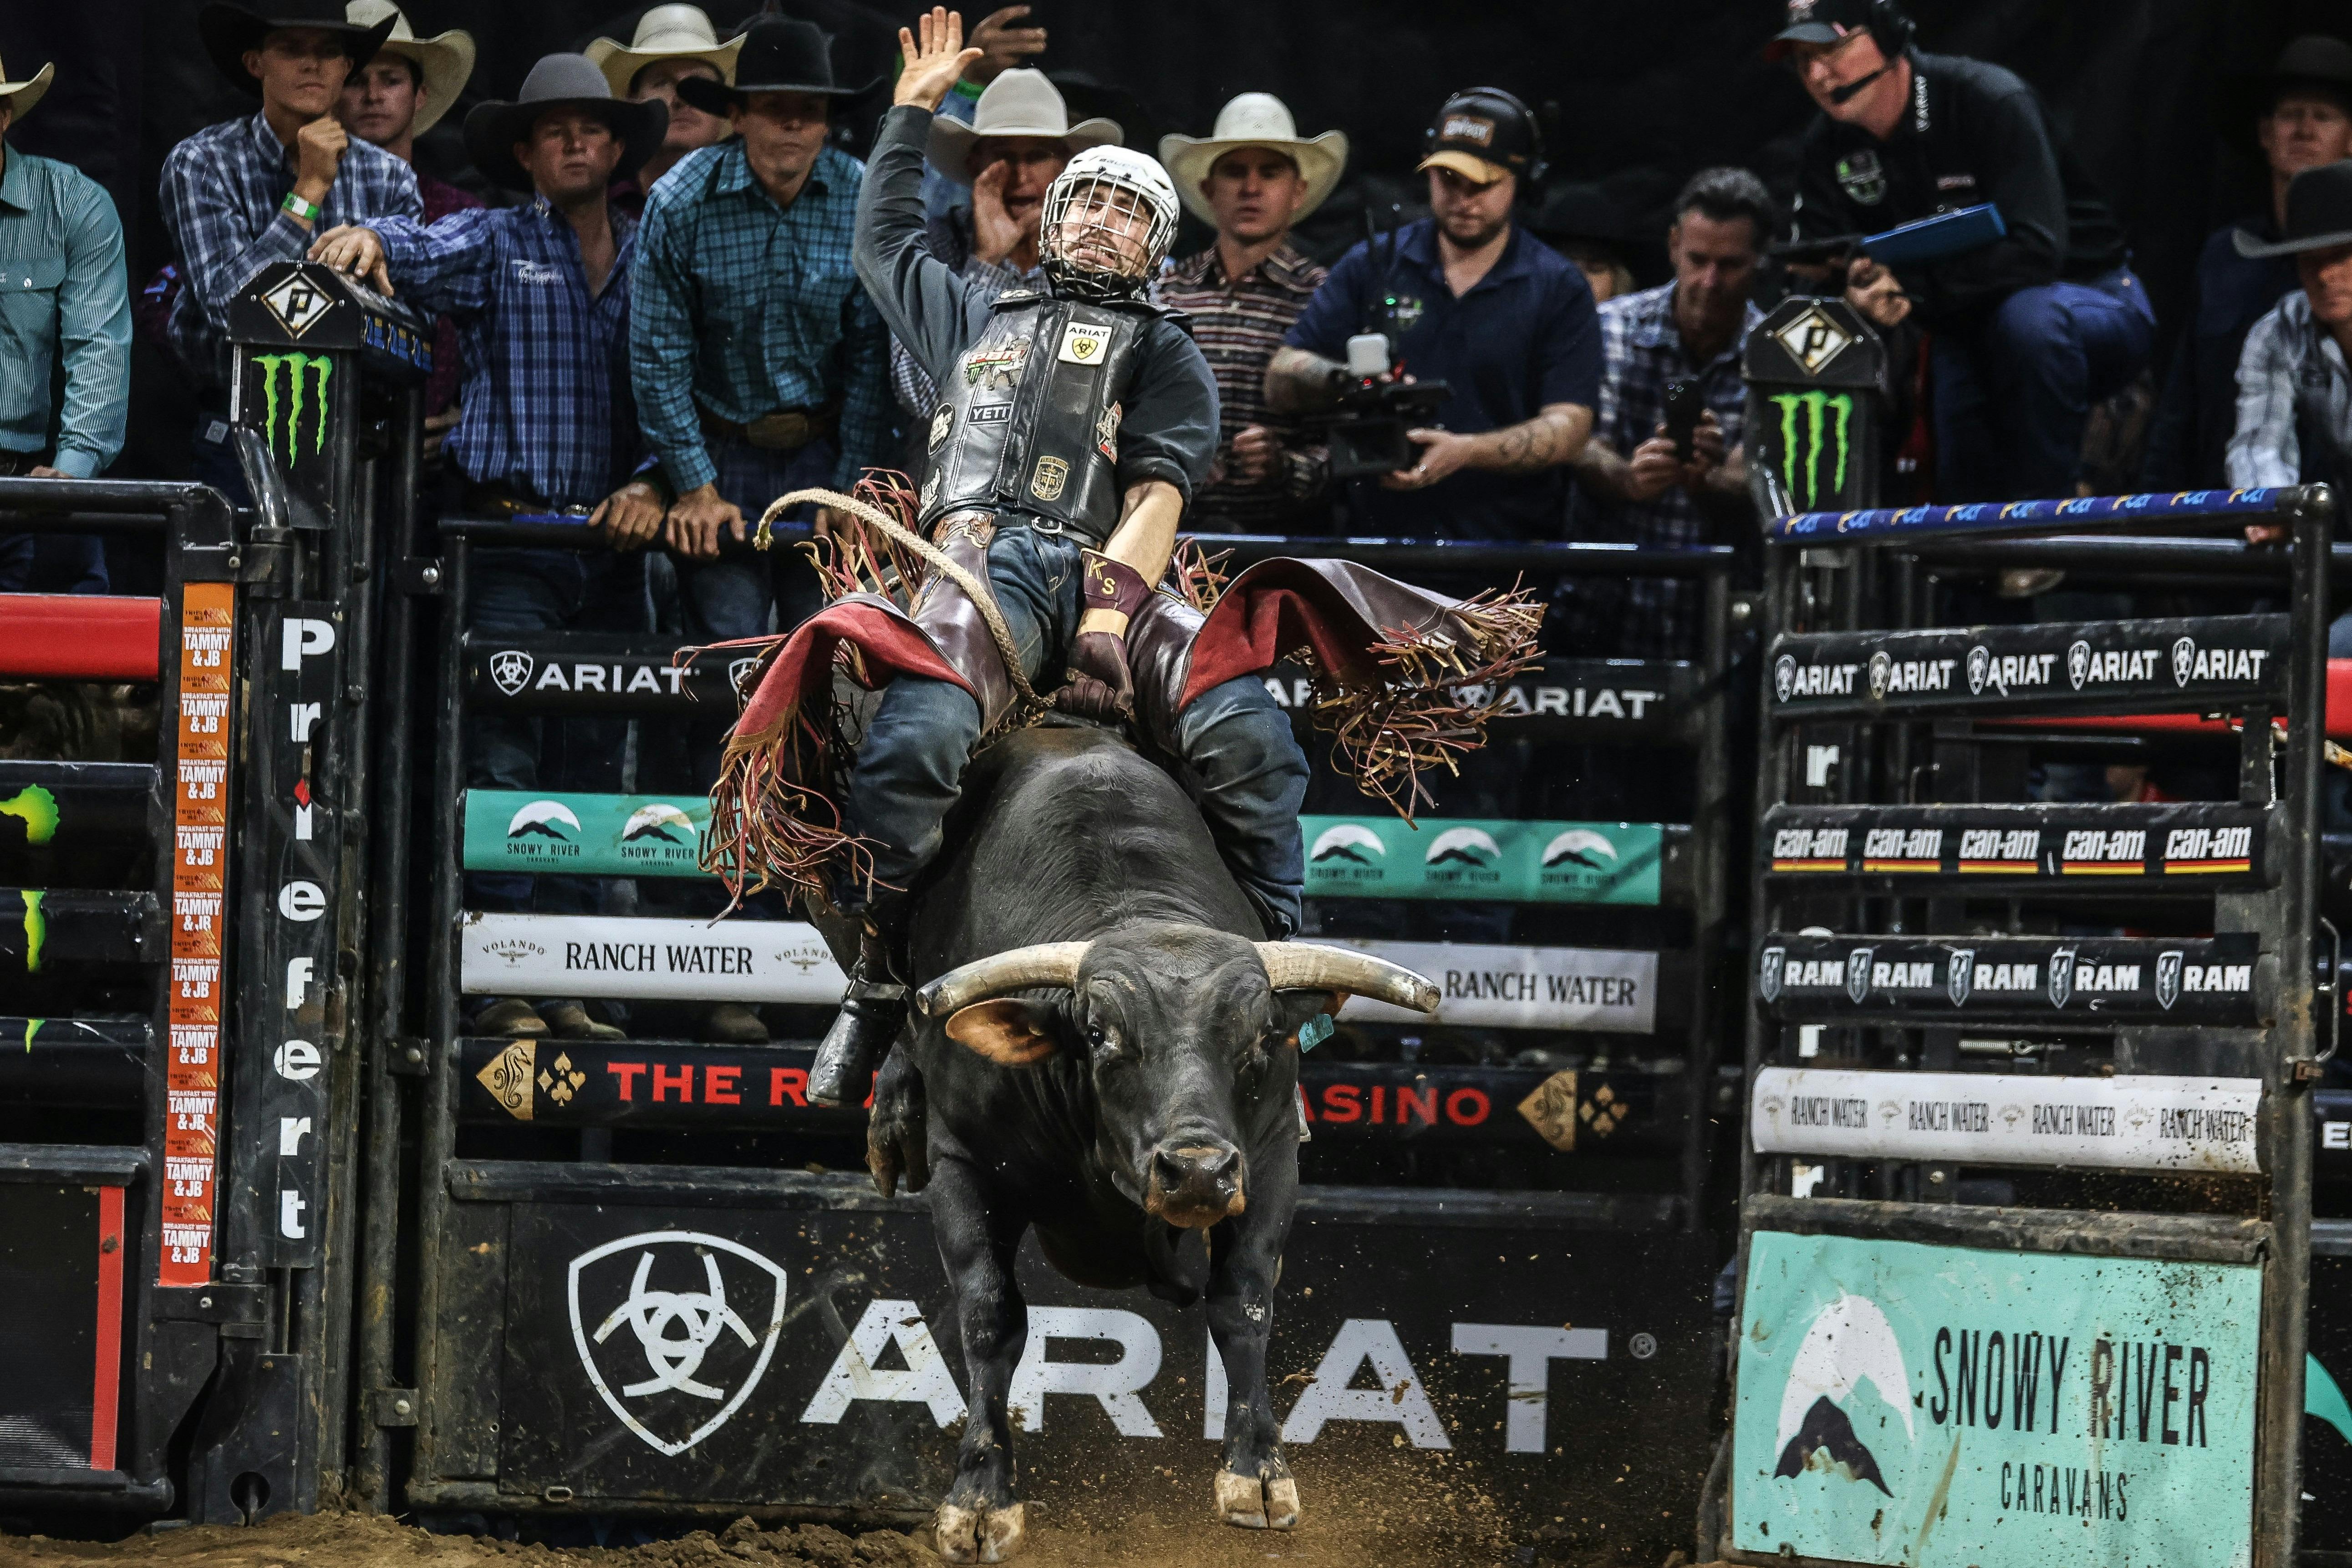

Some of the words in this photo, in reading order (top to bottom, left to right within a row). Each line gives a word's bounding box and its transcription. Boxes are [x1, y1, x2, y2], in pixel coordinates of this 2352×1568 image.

[1069, 327, 1109, 337] ARIAT
[973, 406, 1008, 420] YETI
[1087, 558, 1107, 580] K
[1102, 578, 1115, 595] S
[184, 633, 230, 650] TAMMY
[193, 650, 202, 666] &
[204, 650, 220, 667] JB
[535, 663, 691, 694] ARIAT
[1793, 664, 1858, 695] ARIAT
[1888, 659, 1956, 692] ARIAT
[1985, 654, 2056, 687] ARIAT
[2087, 650, 2159, 683] ARIAT
[2191, 649, 2266, 680] ARIAT
[182, 700, 228, 717] TAMMY
[1500, 685, 1656, 720] ARIAT
[190, 716, 200, 733] &
[202, 716, 218, 733] JB
[179, 766, 225, 783] TAMMY
[188, 782, 198, 799] &
[199, 783, 216, 800] JB
[177, 832, 223, 849] TAMMY
[1772, 828, 1849, 858] can-am
[1863, 829, 1943, 858] can-am
[1959, 829, 2040, 859] can-am
[2062, 829, 2147, 860] can-am
[2165, 826, 2252, 859] can-am
[186, 849, 196, 865] &
[197, 849, 214, 866] JB
[507, 842, 542, 855] SNOWY
[550, 843, 580, 857] RIVER
[621, 846, 657, 858] SNOWY
[665, 847, 694, 860] RIVER
[175, 899, 221, 916] TAMMY
[183, 915, 193, 931] &
[482, 939, 545, 955] VOLANDO
[565, 942, 656, 972] RANCH
[666, 944, 753, 975] WATER
[173, 965, 219, 982] TAMMY
[1784, 960, 1844, 987] RAM
[1872, 961, 1934, 988] RAM
[1974, 963, 2037, 990] RAM
[2075, 965, 2141, 992] RAM
[2183, 965, 2251, 992] RAM
[182, 981, 191, 998] &
[193, 981, 209, 998] JB
[1445, 969, 1535, 1001] RANCH
[1548, 973, 1637, 1006] WATER
[170, 1031, 217, 1048] TAMMY
[179, 1047, 189, 1064] &
[191, 1047, 207, 1064] JB
[607, 1061, 742, 1106] THE
[168, 1097, 215, 1114] TAMMY
[178, 1114, 187, 1130] &
[189, 1114, 205, 1130] JB
[2032, 1104, 2073, 1135] RANCH
[2077, 1105, 2115, 1136] WATER
[2160, 1107, 2201, 1139] RANCH
[166, 1163, 212, 1181] TAMMY
[174, 1180, 184, 1197] &
[186, 1181, 203, 1197] JB
[163, 1230, 210, 1248] TAMMY
[171, 1246, 182, 1264] &
[183, 1247, 200, 1264] JB
[1930, 1326, 2070, 1435] SNOWY
[2089, 1338, 2210, 1448] RIVER
[2001, 1461, 2128, 1522] CARAVANS
